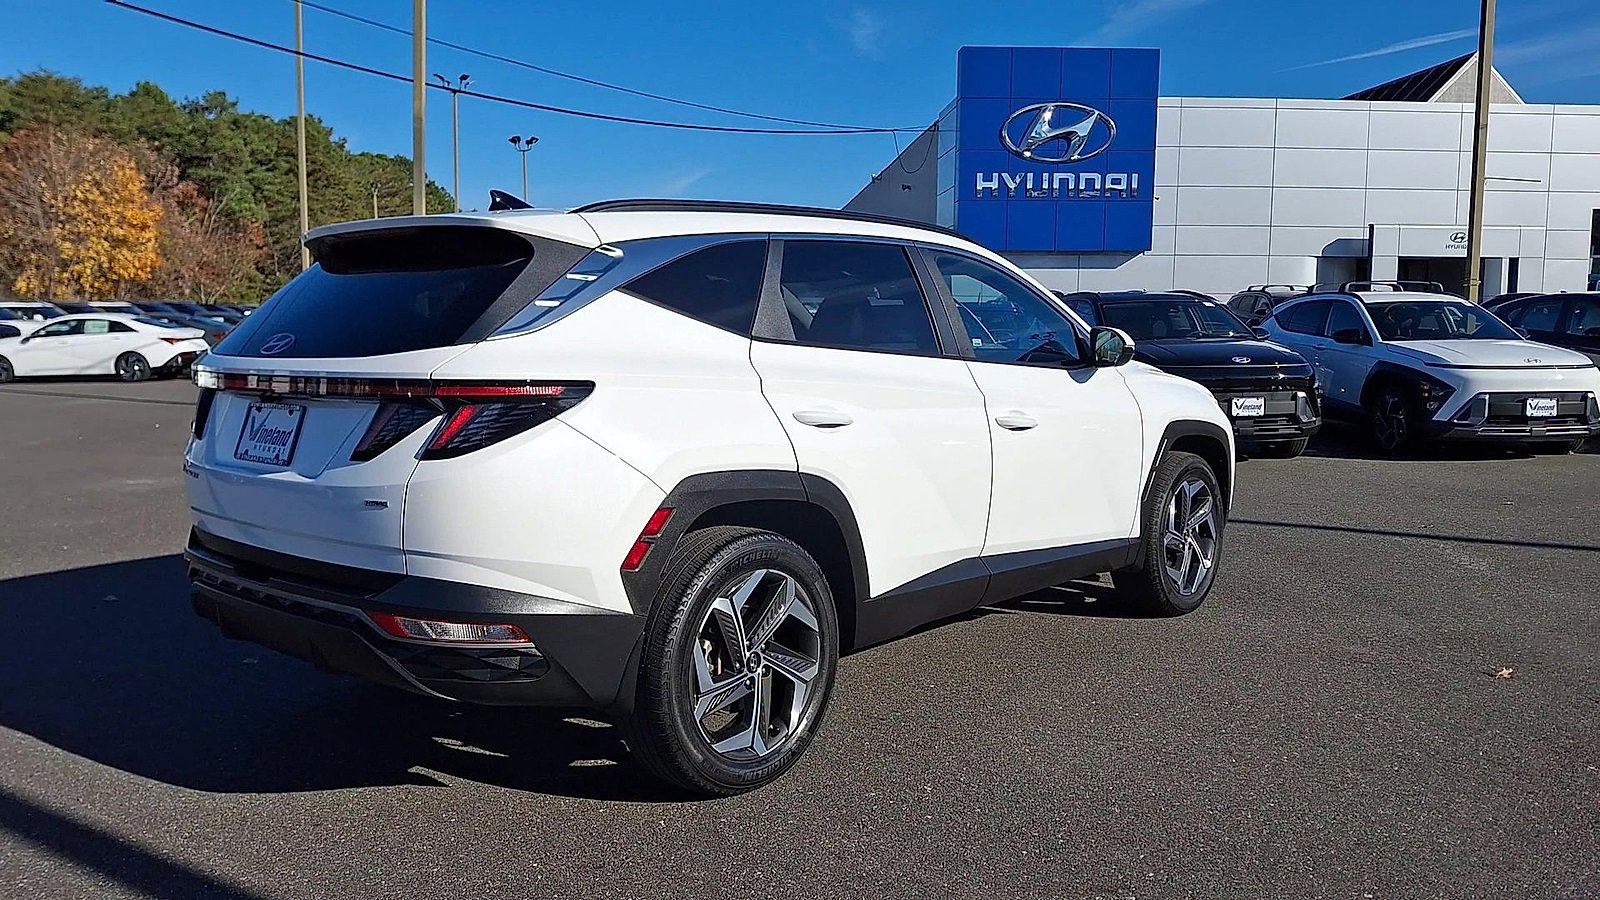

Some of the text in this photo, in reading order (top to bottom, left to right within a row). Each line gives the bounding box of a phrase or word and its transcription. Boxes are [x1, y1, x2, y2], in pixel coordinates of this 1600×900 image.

[976, 172, 1138, 197] HYUNDAI
[1234, 399, 1262, 411] Vineland
[249, 409, 294, 447] Vineland
[729, 549, 783, 573] MICHELIN
